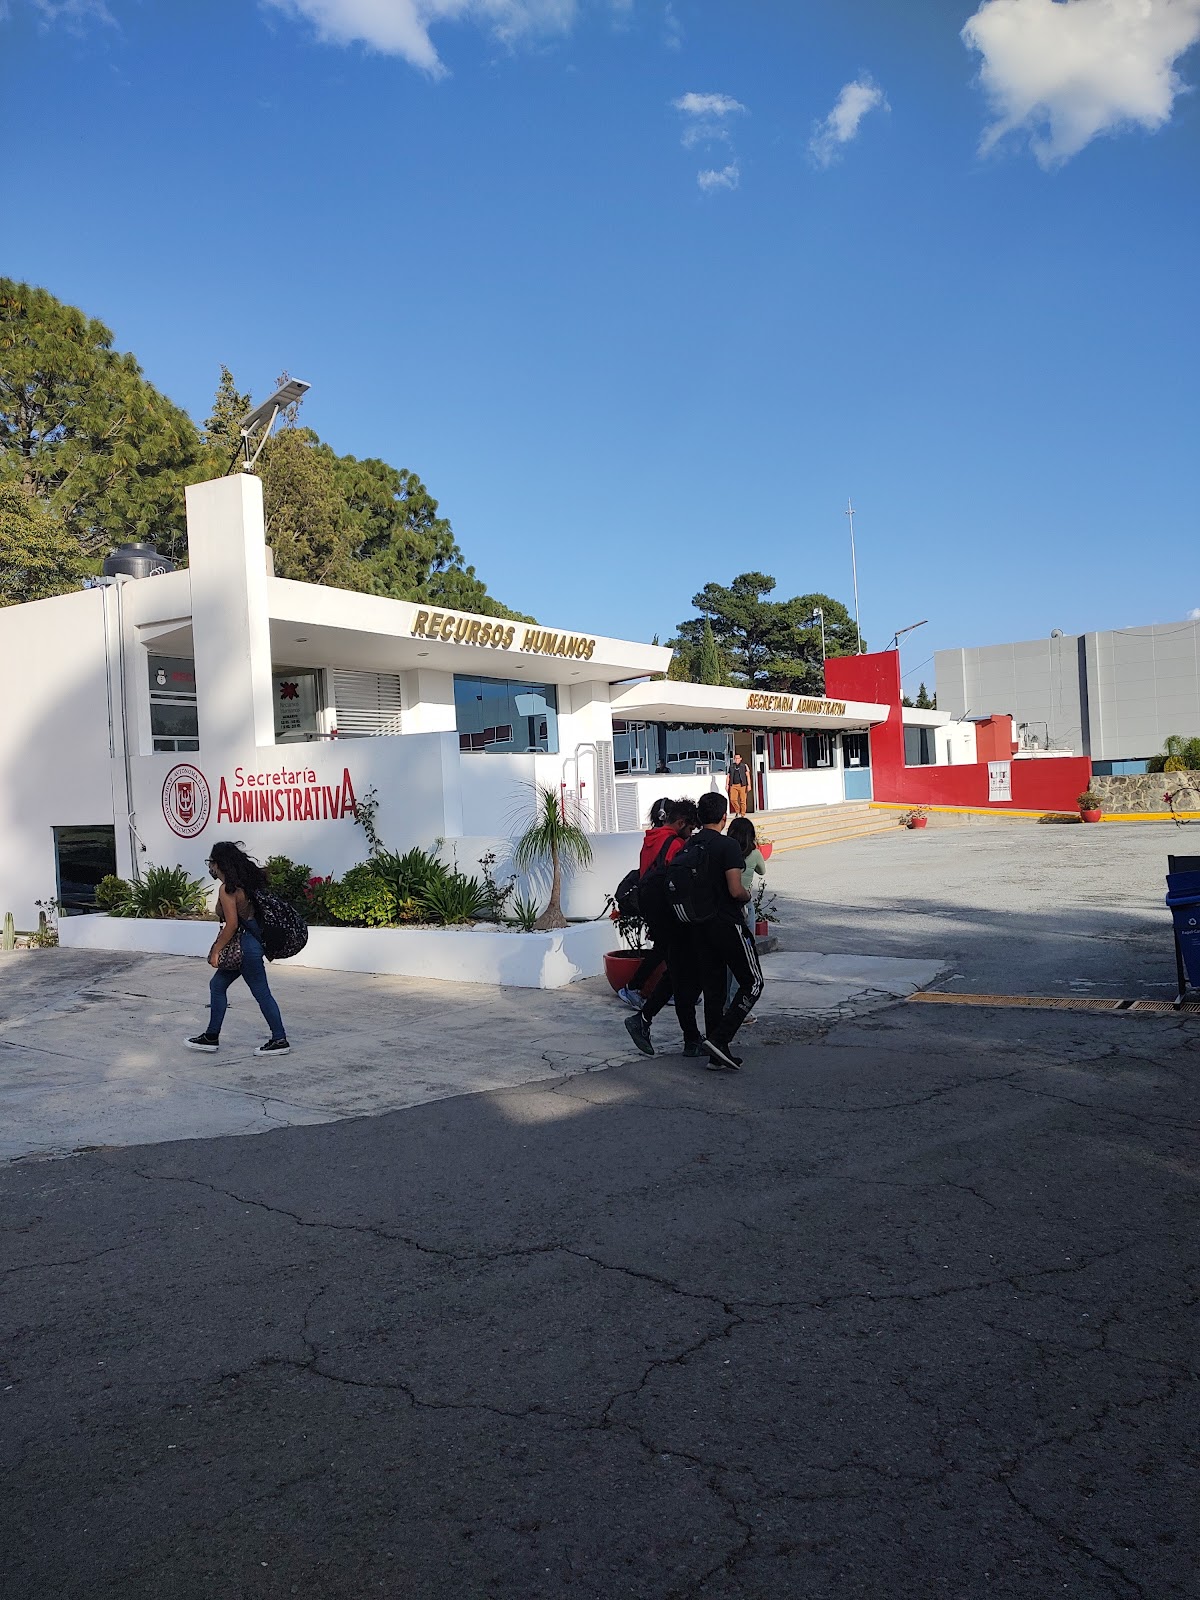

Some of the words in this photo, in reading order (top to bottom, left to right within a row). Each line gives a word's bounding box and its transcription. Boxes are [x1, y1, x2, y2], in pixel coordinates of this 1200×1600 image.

[410, 609, 516, 650] RECURSOS
[520, 628, 596, 661] HUMANOS
[746, 693, 794, 712] SECRETARIA
[794, 698, 847, 717] ADMINISTRATIVA
[217, 768, 357, 823] ADMINISTRATIVA
[234, 766, 317, 787] Secretaría
